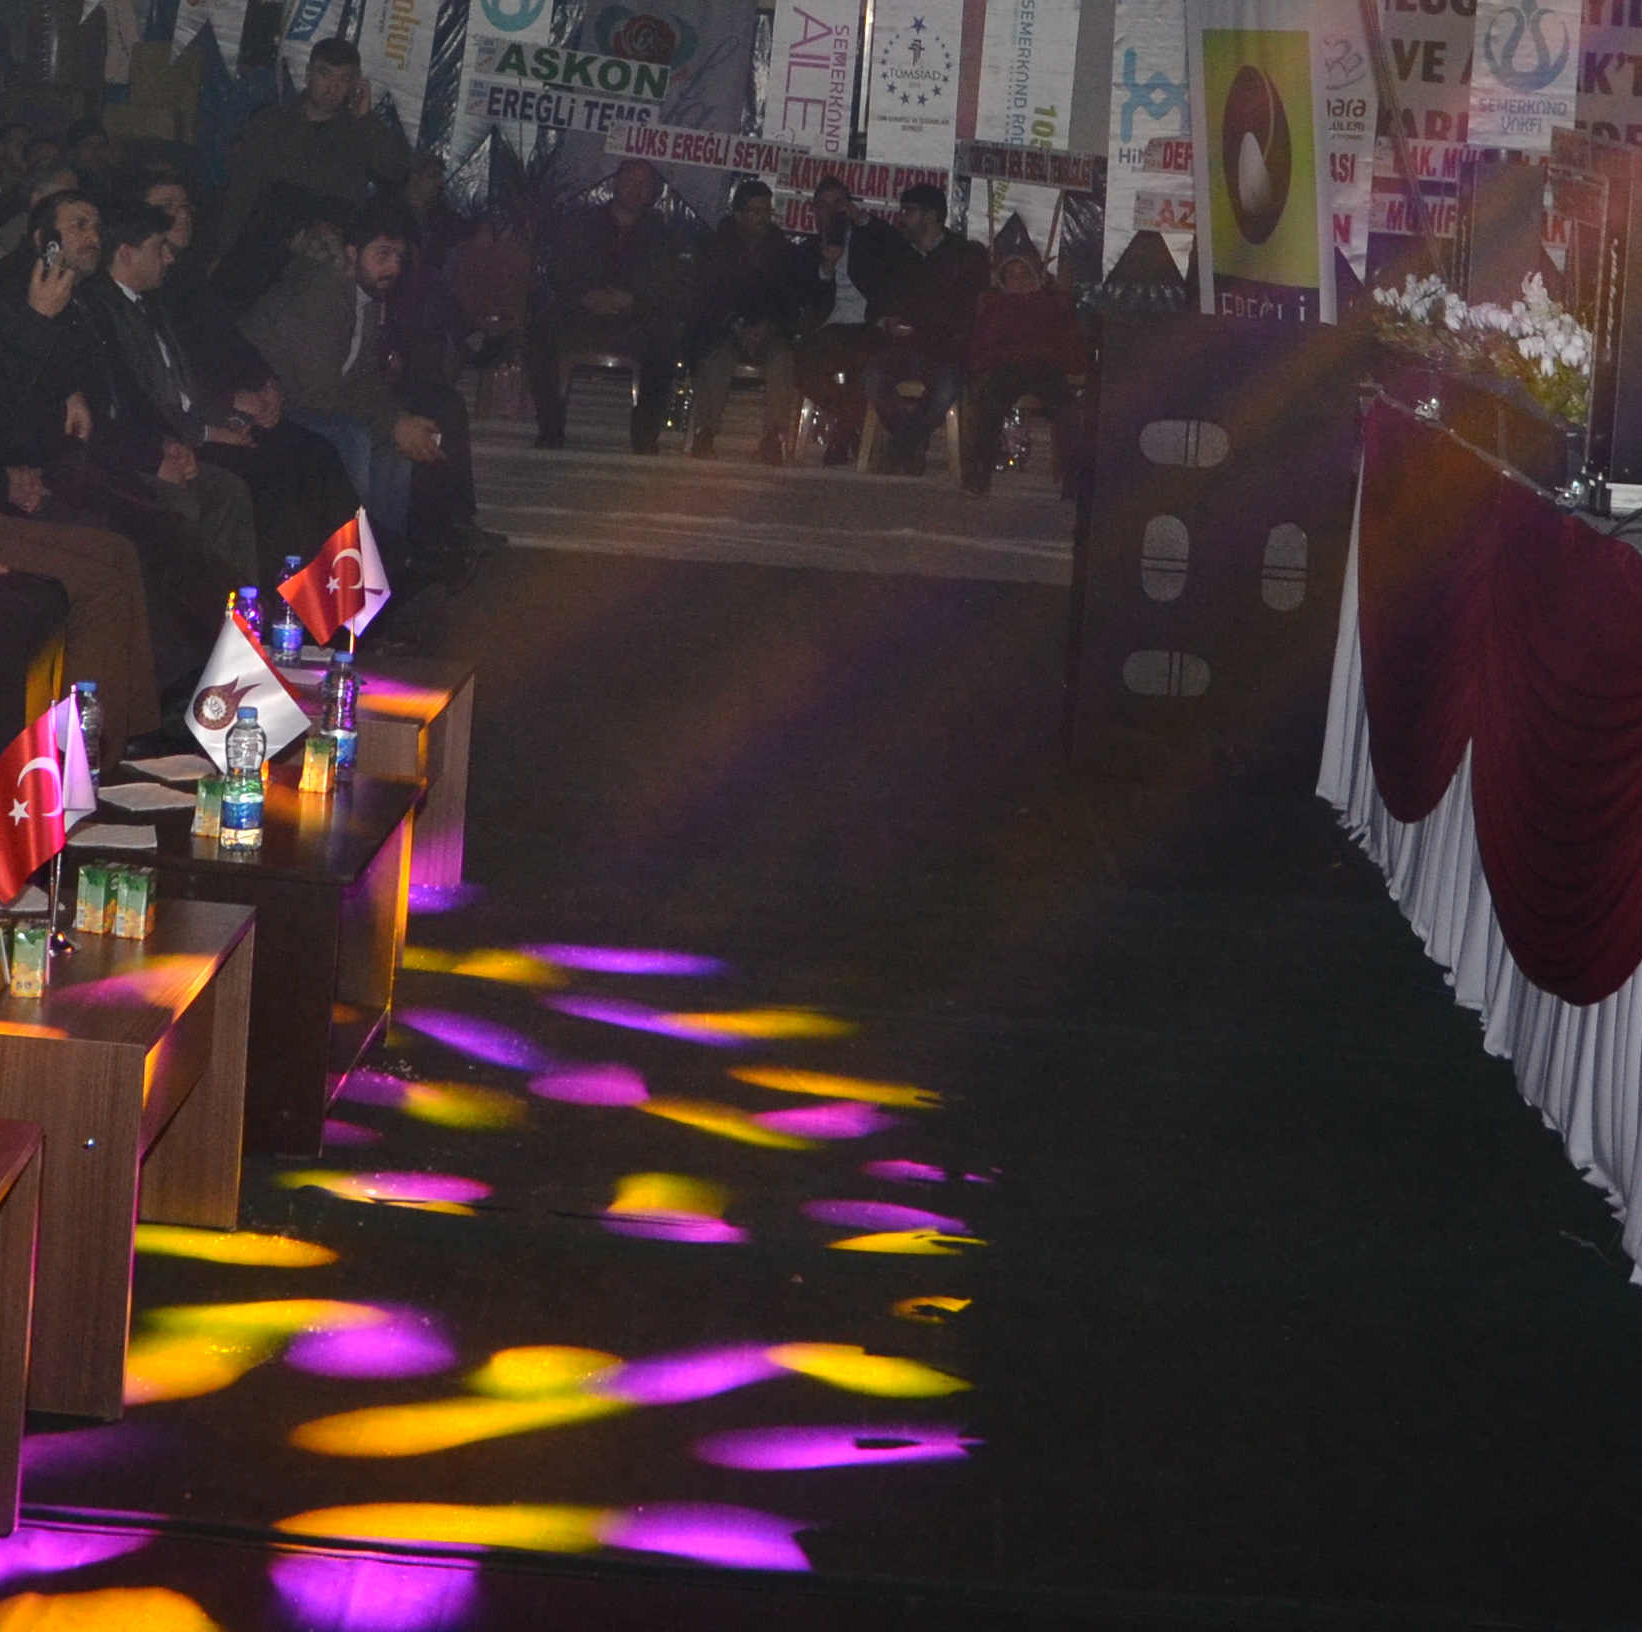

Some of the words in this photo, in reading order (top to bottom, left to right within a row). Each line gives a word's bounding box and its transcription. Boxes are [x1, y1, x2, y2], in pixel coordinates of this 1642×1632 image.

[495, 43, 670, 99] ASKON
[1390, 38, 1448, 85] VE
[625, 123, 669, 158] LÜKS
[671, 132, 732, 166] EREĞLİ
[733, 141, 810, 174] SEYA
